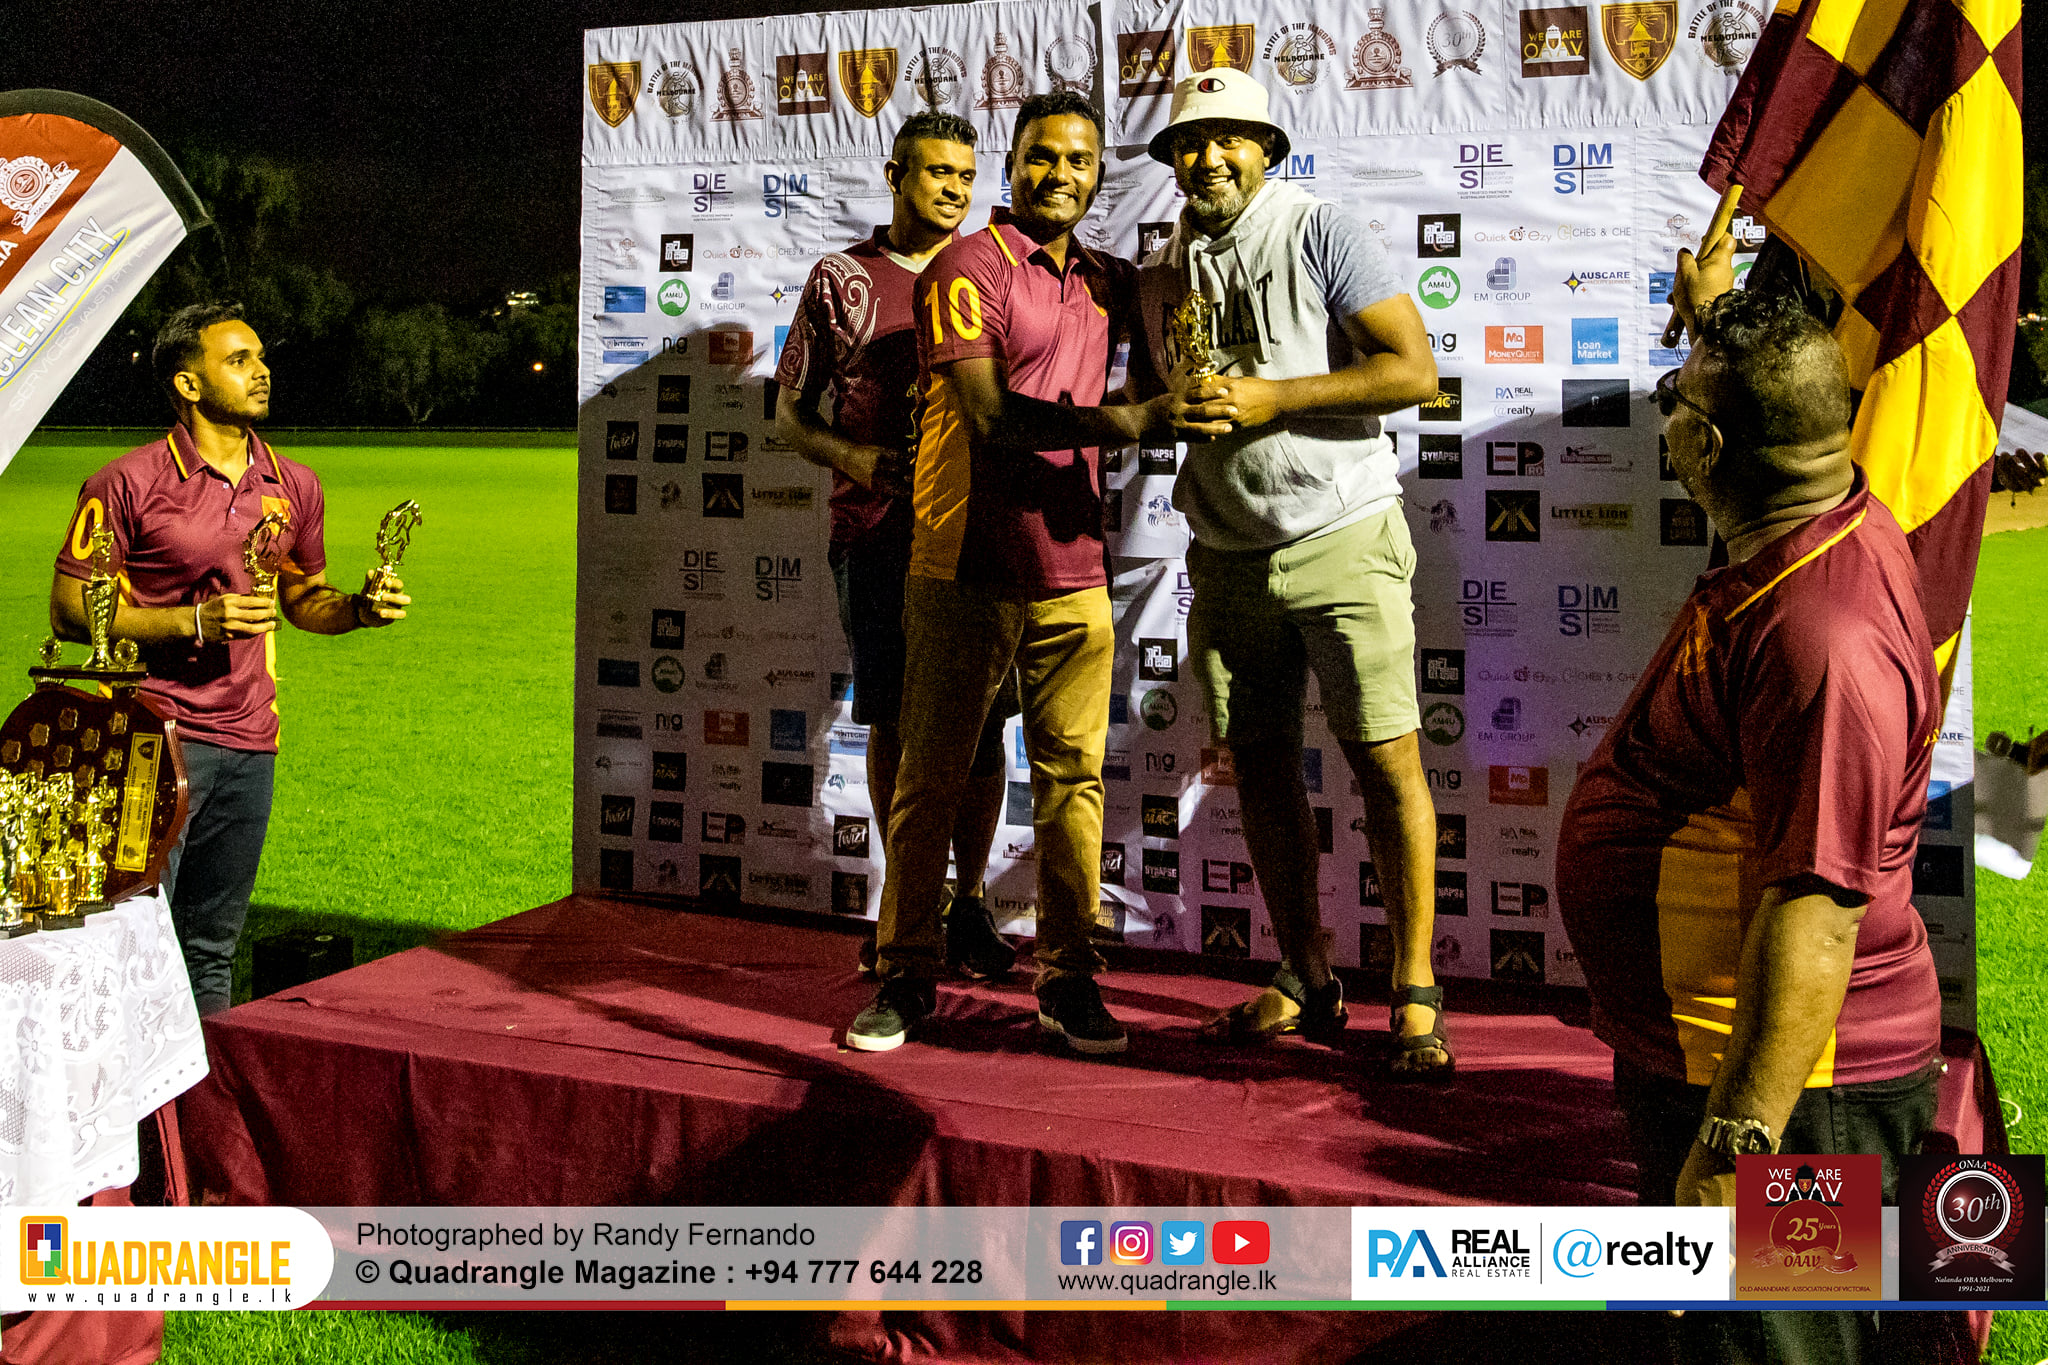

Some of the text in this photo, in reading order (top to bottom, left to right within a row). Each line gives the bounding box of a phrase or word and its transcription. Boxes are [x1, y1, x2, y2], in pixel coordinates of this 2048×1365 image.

[1688, 9, 1707, 40] BATTLE
[1707, 3, 1719, 14] OF
[1719, 0, 1734, 9] THE
[1528, 30, 1582, 41] WE ARE
[1700, 32, 1758, 42] MELBOURNE
[1263, 32, 1281, 61] BATTLE
[1281, 25, 1291, 35] OF
[1292, 22, 1305, 31] THE
[1274, 53, 1325, 63] MELBOURNE
[669, 60, 682, 68] THE
[905, 55, 919, 82] BATTLE
[929, 46, 941, 54] THE
[808, 73, 824, 82] ARE
[1474, 230, 1507, 242] Quick
[1580, 271, 1631, 280] AUSCARE
[1428, 280, 1451, 290] AM4U
[0, 215, 117, 378] CLEAN CITY
[664, 291, 683, 300] AM4U
[1473, 291, 1531, 302] EM GROUP
[700, 303, 746, 312] EM GROUP
[924, 276, 983, 345] 10
[1577, 340, 1601, 351] Loan
[1577, 350, 1613, 360] Market
[9, 320, 81, 412] SERVICES
[1140, 448, 1175, 460] SYNAPSE
[1421, 450, 1461, 463] SYNAPSE
[1551, 506, 1594, 520] LITTLE
